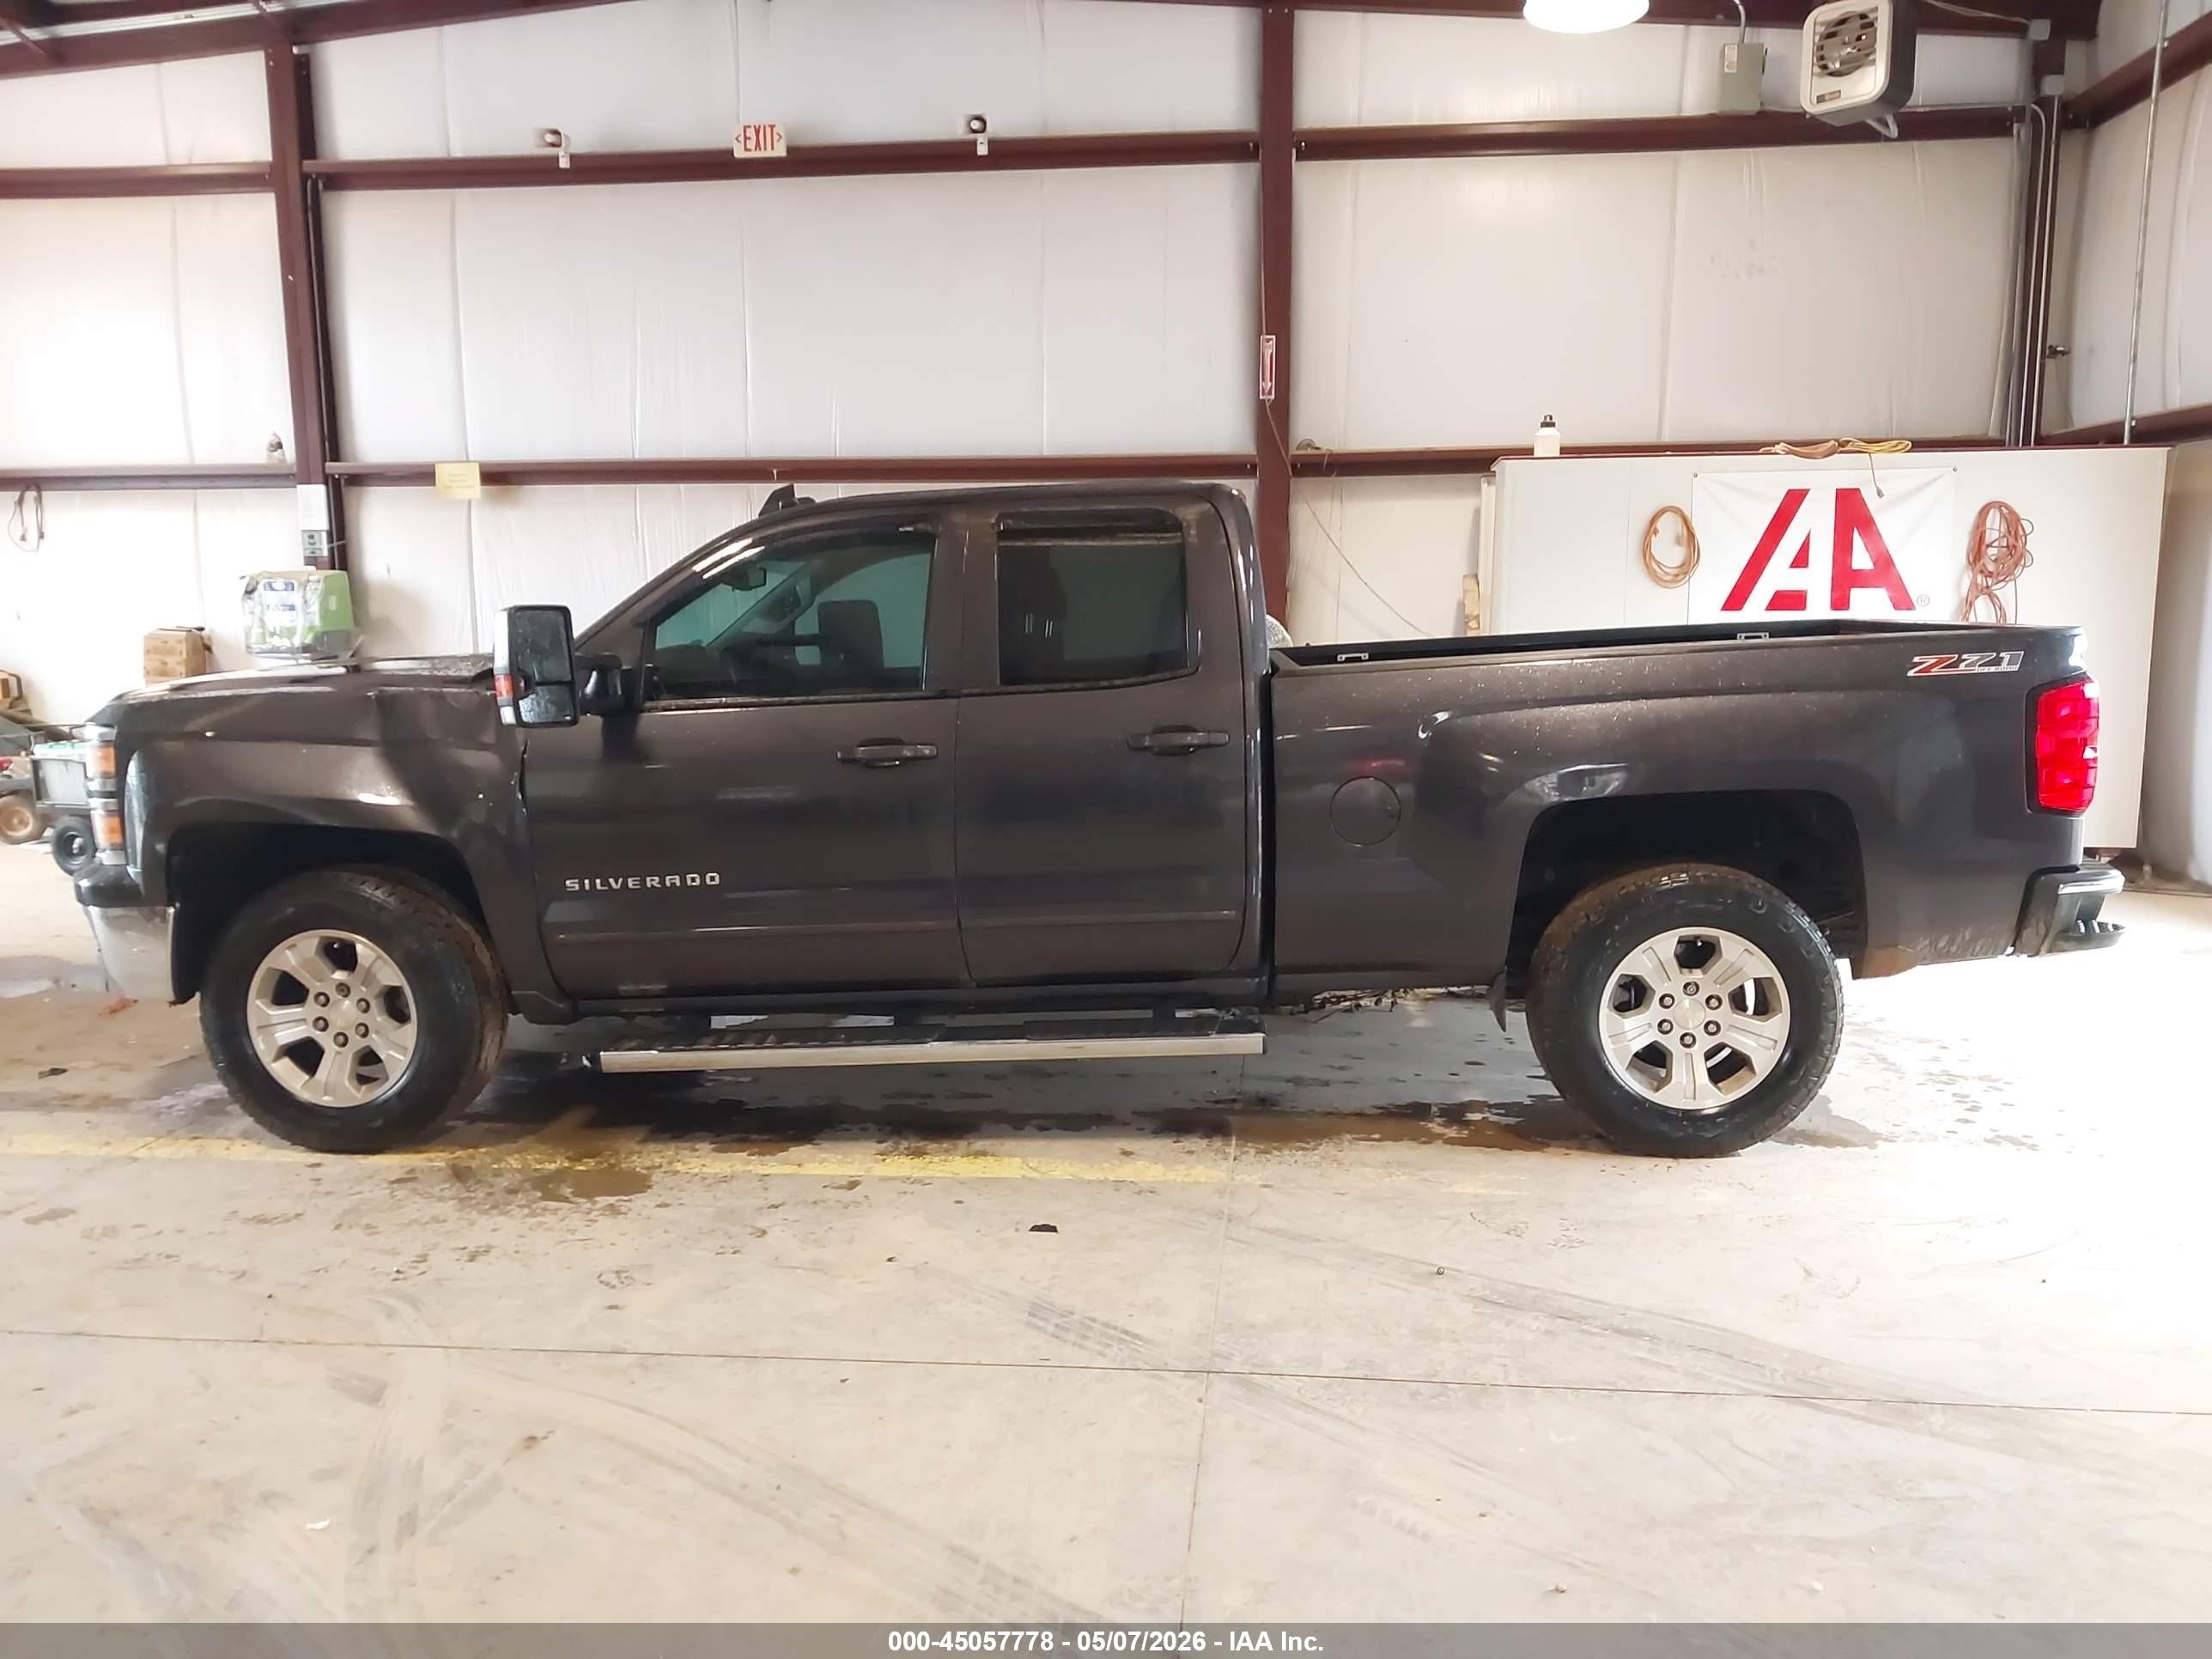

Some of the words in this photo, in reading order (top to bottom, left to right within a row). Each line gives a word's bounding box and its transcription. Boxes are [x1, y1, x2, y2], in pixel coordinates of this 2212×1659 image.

[743, 124, 776, 152] EXIT
[1906, 650, 2025, 677] Z71
[564, 872, 721, 891] SILVERADO
